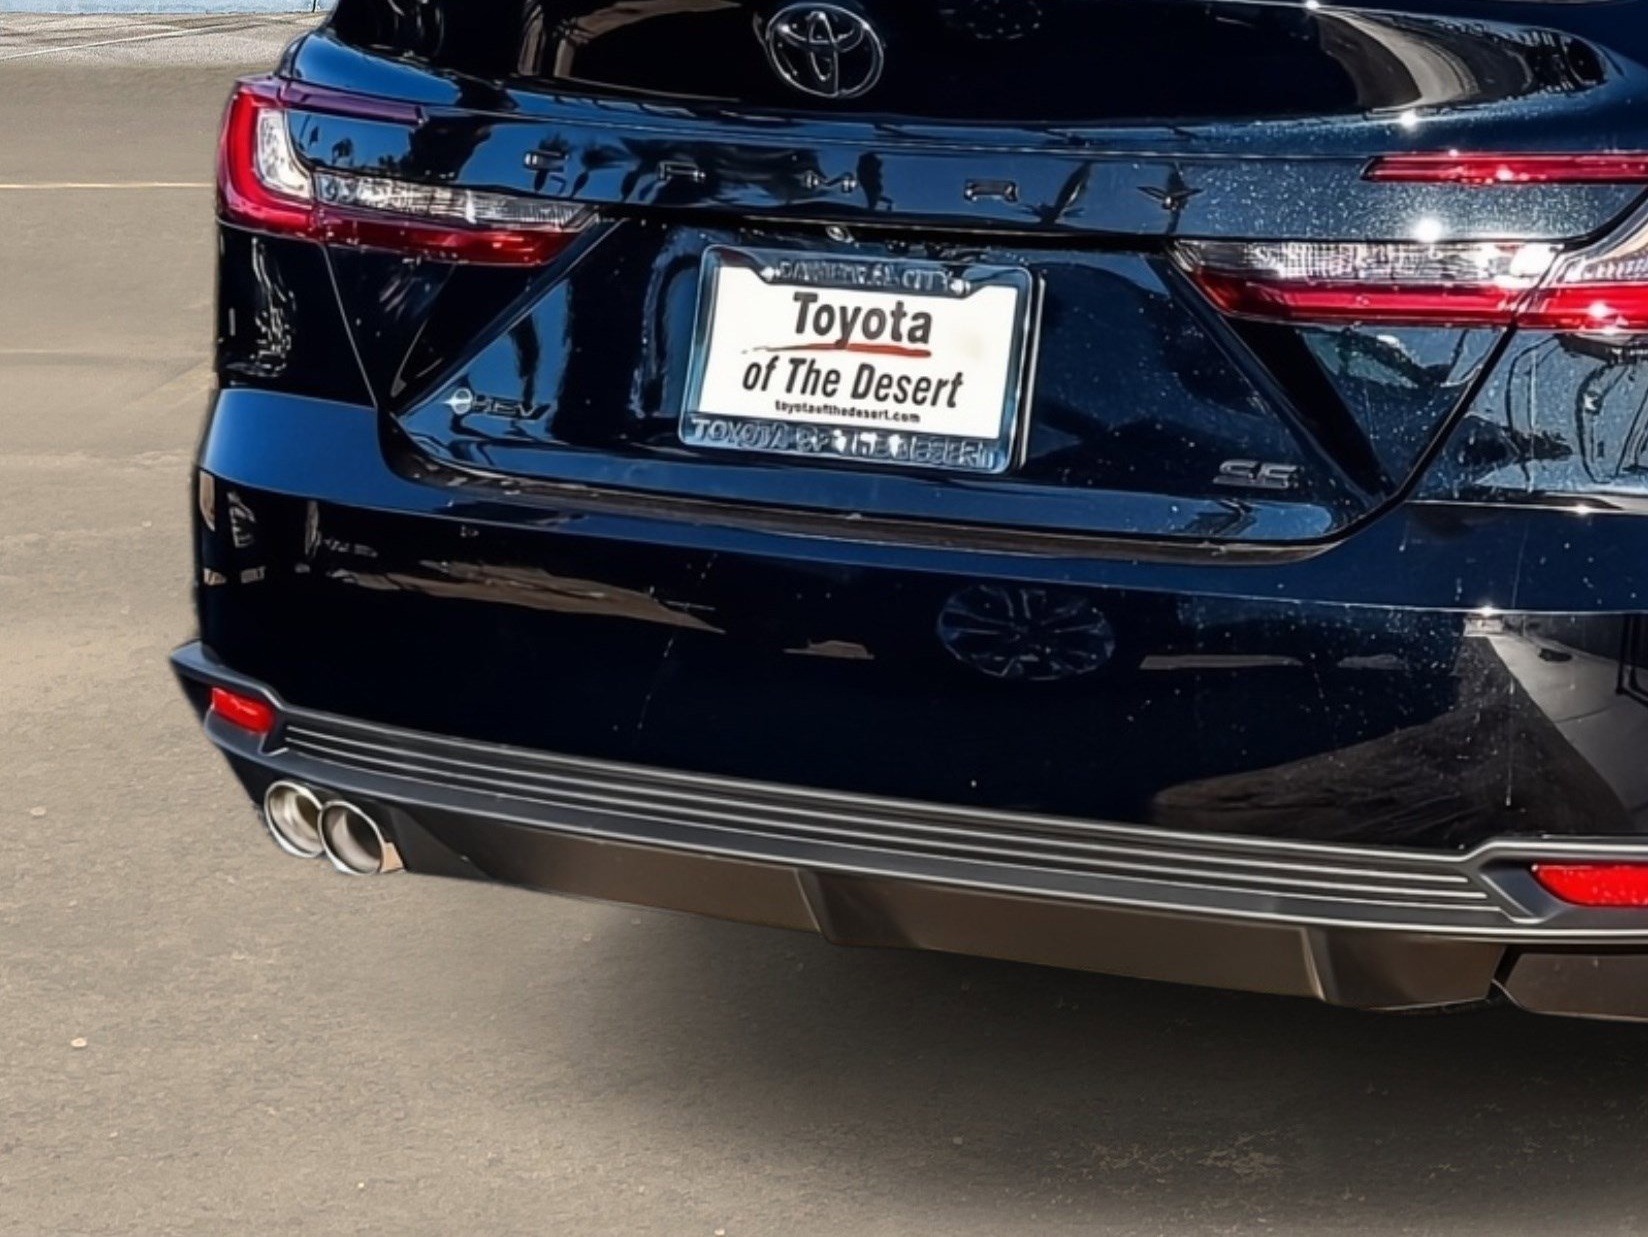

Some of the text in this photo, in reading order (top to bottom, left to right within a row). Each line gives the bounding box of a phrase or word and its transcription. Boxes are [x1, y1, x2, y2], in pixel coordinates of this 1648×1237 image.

[792, 291, 933, 351] Toyota
[742, 356, 964, 409] of The Desert
[774, 399, 921, 424] toyotaofthedesert.com
[690, 417, 790, 451] TOYOTA
[1212, 459, 1298, 490] SE
